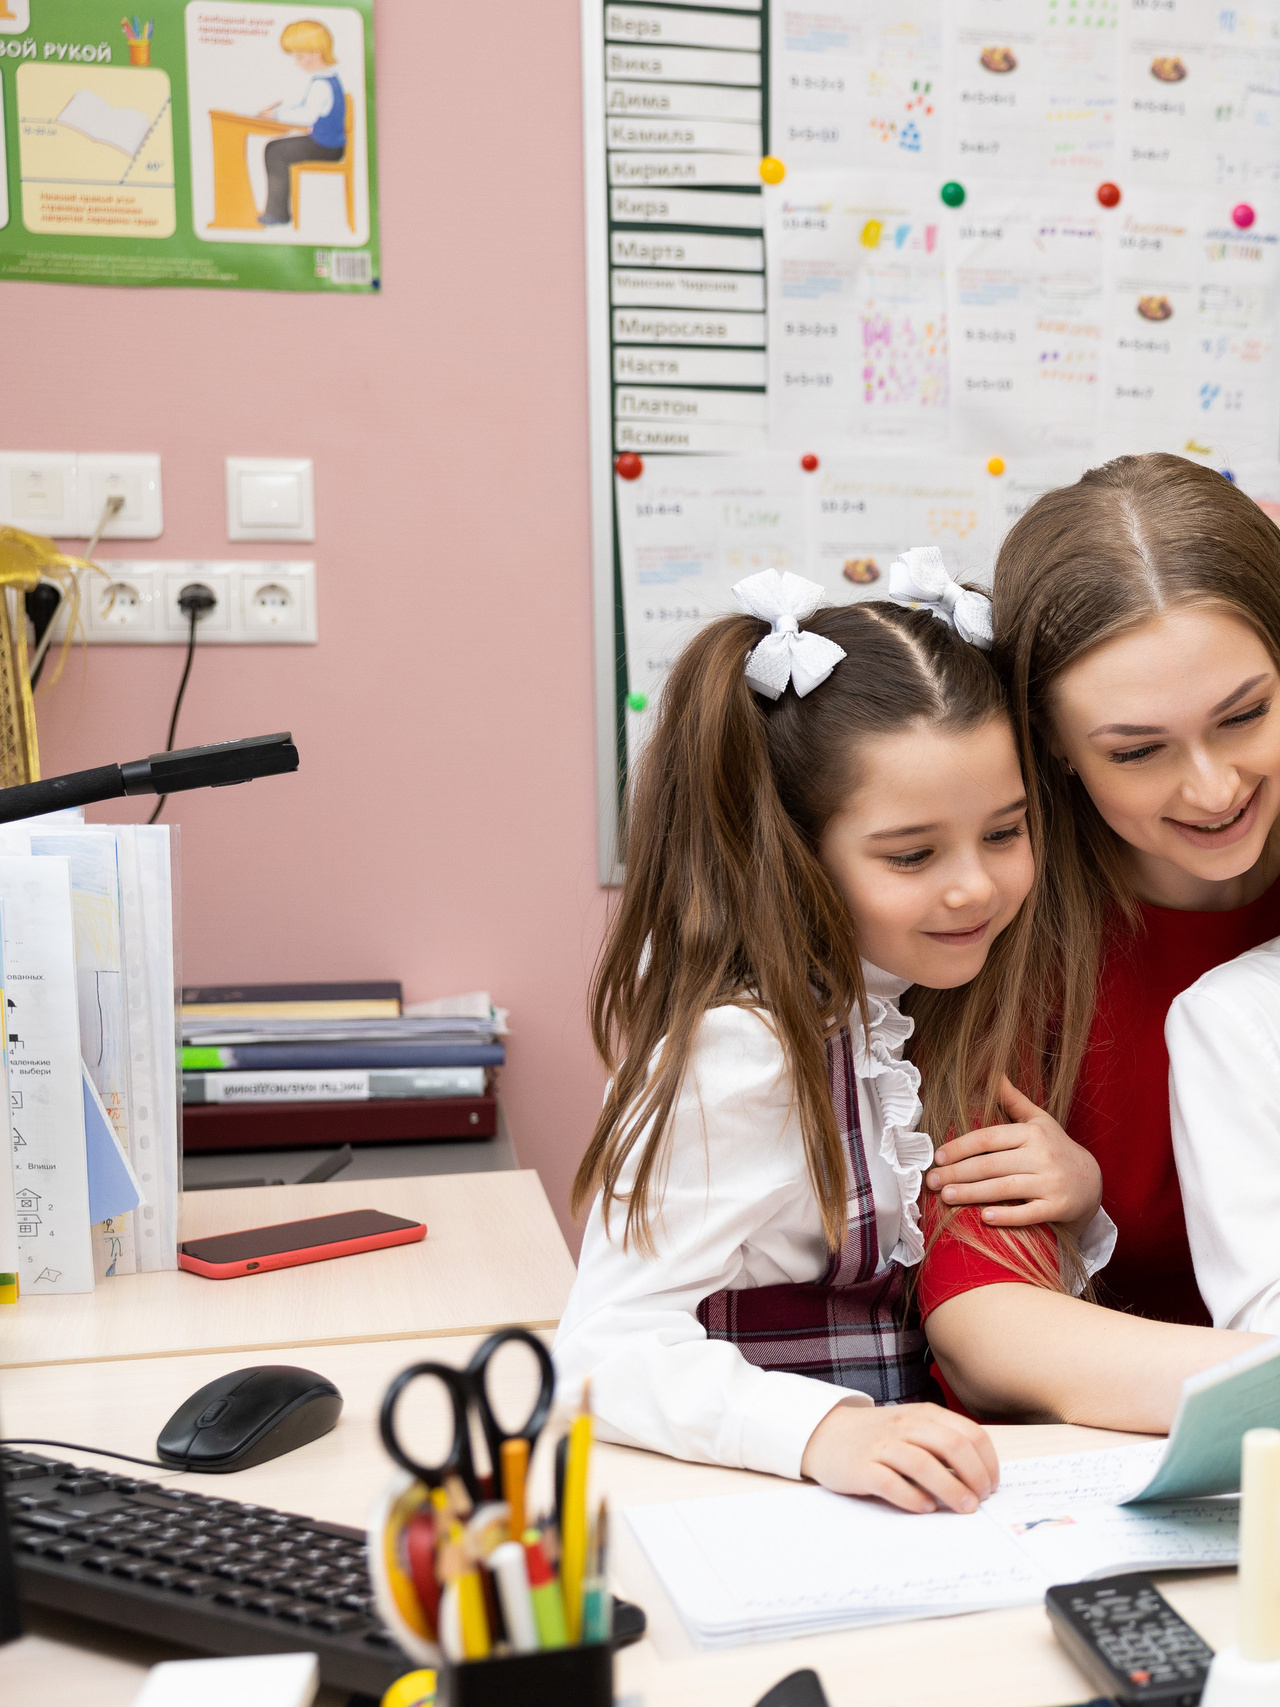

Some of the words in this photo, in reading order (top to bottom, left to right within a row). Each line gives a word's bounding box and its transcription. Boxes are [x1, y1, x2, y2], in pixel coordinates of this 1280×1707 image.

[611, 14, 661, 38] Вера
[43, 41, 112, 63] РУКОЙ
[611, 53, 662, 75] Вика
[611, 89, 670, 113] Дима
[614, 126, 694, 144] Камила
[617, 161, 696, 184] Кирилл
[617, 195, 669, 220] Кира
[618, 241, 685, 263] Марта
[616, 276, 675, 291] Максим
[620, 317, 727, 341] Мирослав
[620, 355, 679, 377] Настя
[622, 394, 698, 415] Платон
[623, 427, 689, 445] Ясмин
[19, 1067, 52, 1076] выбери
[28, 1162, 57, 1170] Впиши
[48, 1203, 54, 1212] 2
[27, 1256, 33, 1264] 5
